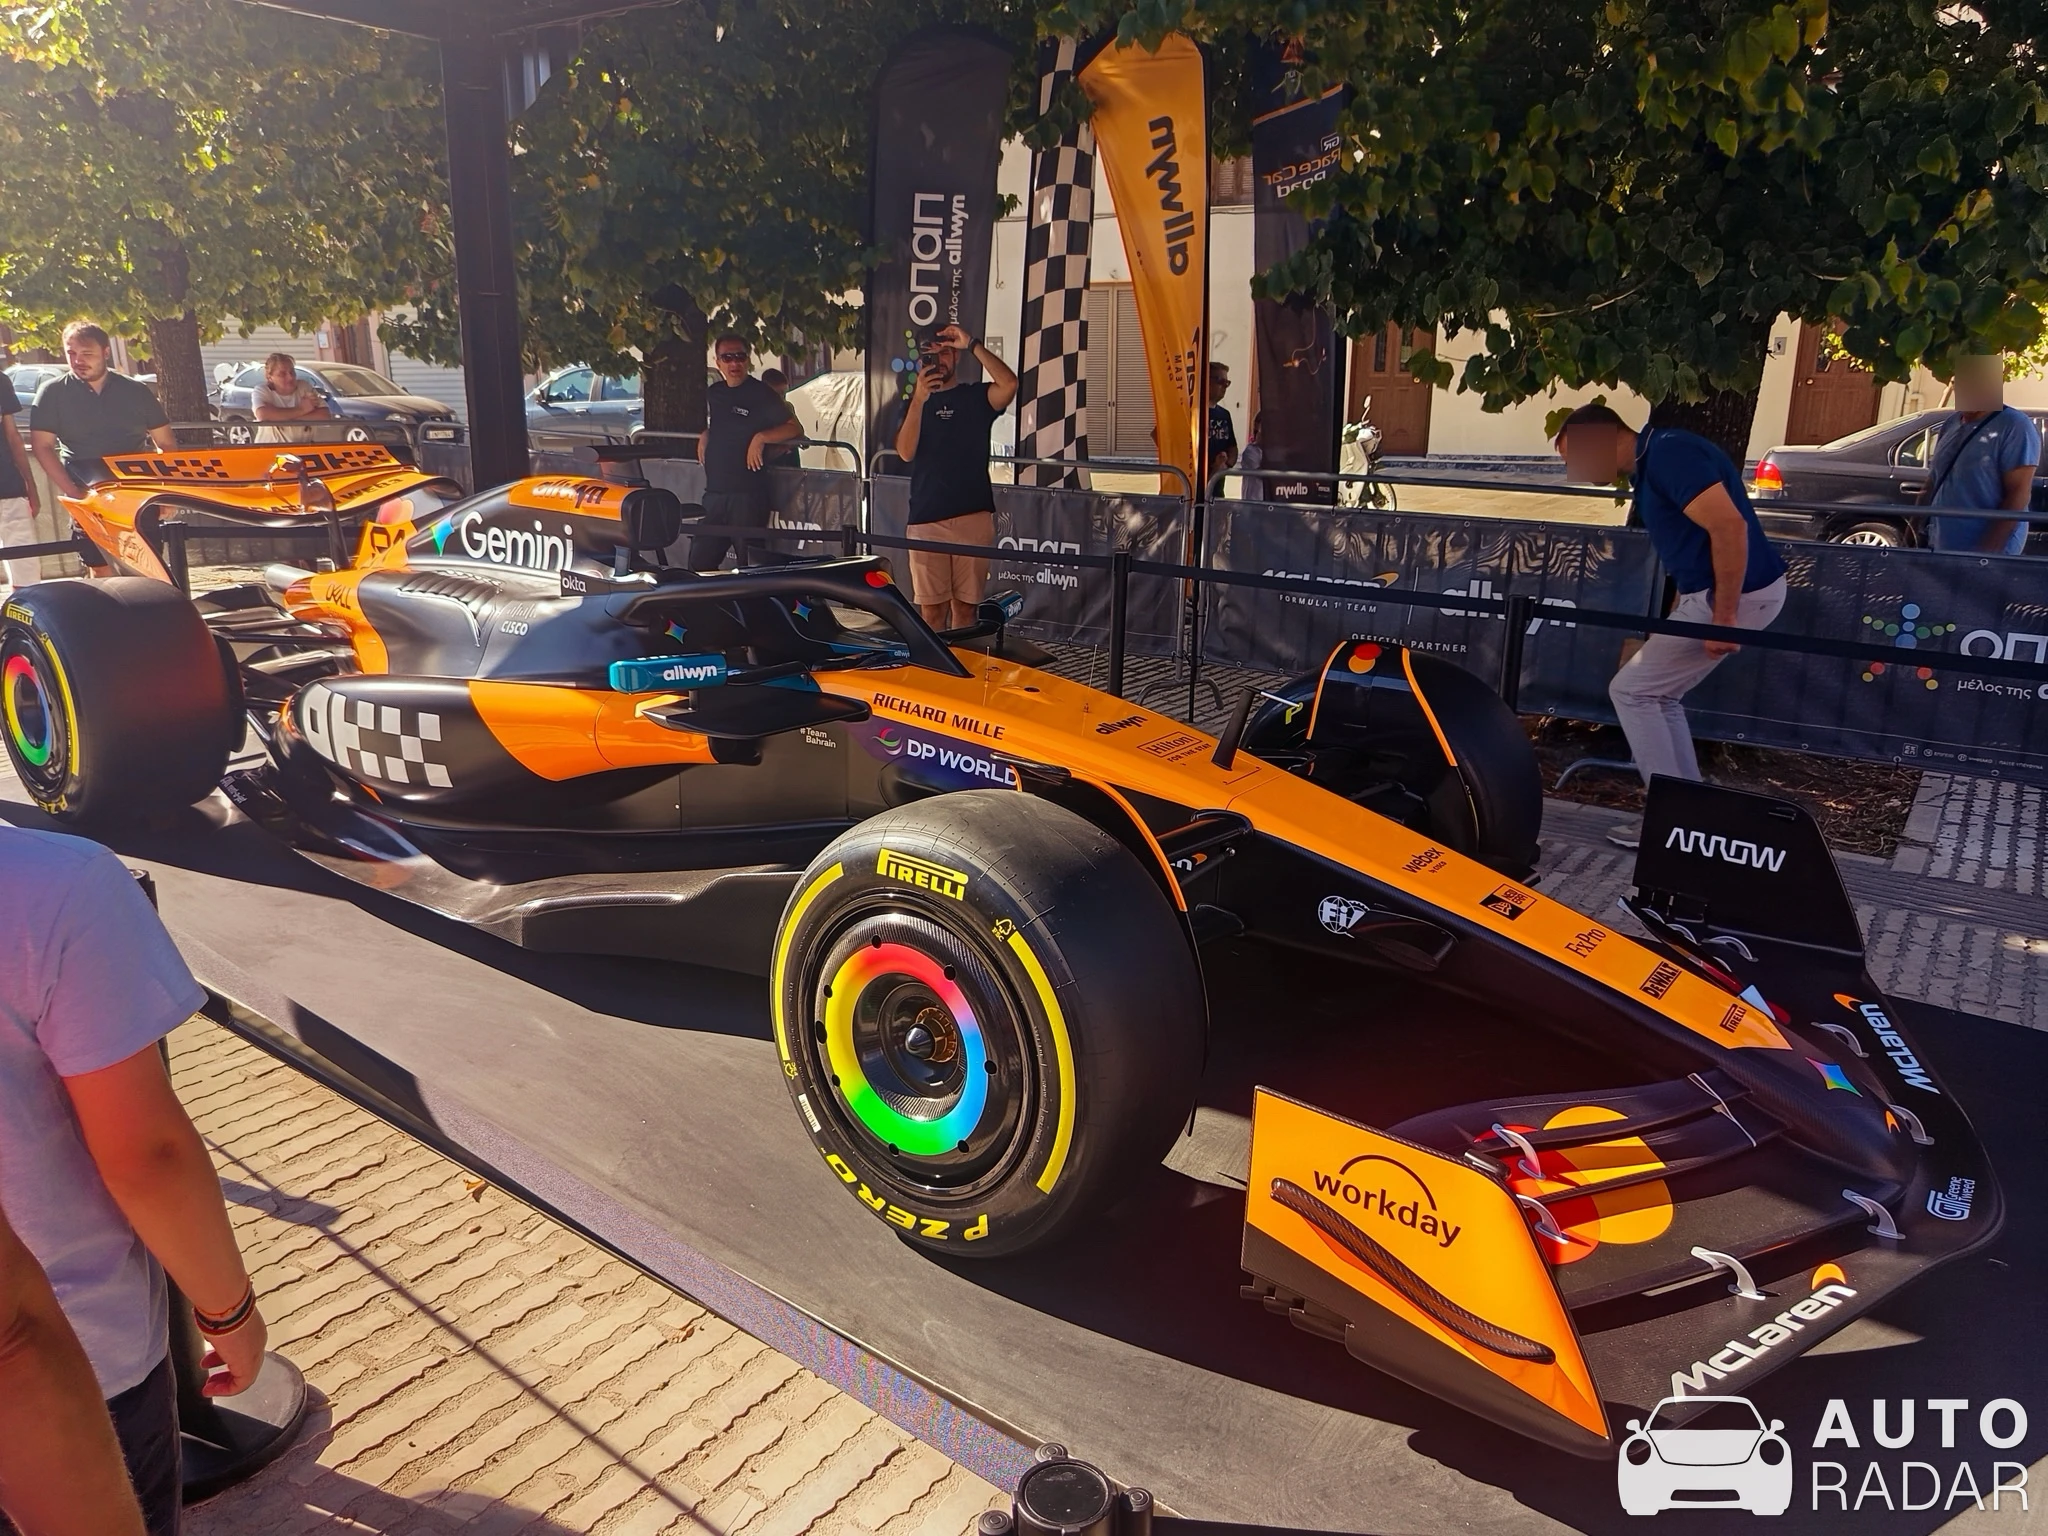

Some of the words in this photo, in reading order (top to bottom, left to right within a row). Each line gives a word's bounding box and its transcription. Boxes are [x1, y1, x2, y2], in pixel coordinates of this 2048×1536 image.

[945, 194, 969, 265] allwyn
[461, 511, 574, 572] Gemini
[562, 575, 587, 593] okta
[1036, 568, 1078, 591] allwyn
[1279, 594, 1328, 608] FORMULA
[1347, 603, 1377, 613] TEAM
[1410, 640, 1468, 653] PARTNER
[663, 665, 717, 681] allwyn
[1957, 678, 2003, 695] μέλος
[2006, 685, 2033, 700] της
[873, 693, 947, 724] RICHARD
[952, 714, 1005, 741] MILLE
[1095, 715, 1148, 735] allwyn
[806, 735, 837, 748] Bahrain
[1146, 735, 1195, 755] Hilton
[907, 739, 936, 760] DP
[939, 748, 1017, 786] WORLD
[1402, 847, 1445, 873] webex
[1665, 827, 1787, 872] ARROW
[876, 848, 969, 901] PIRELLI
[1565, 928, 1607, 958] FxPro
[1719, 1003, 1747, 1033] PIRELLI
[1859, 1003, 1941, 1095] McLaren
[826, 1153, 950, 1240] ZERO
[1313, 1170, 1461, 1248] workday
[1671, 1284, 1857, 1403] McLaren
